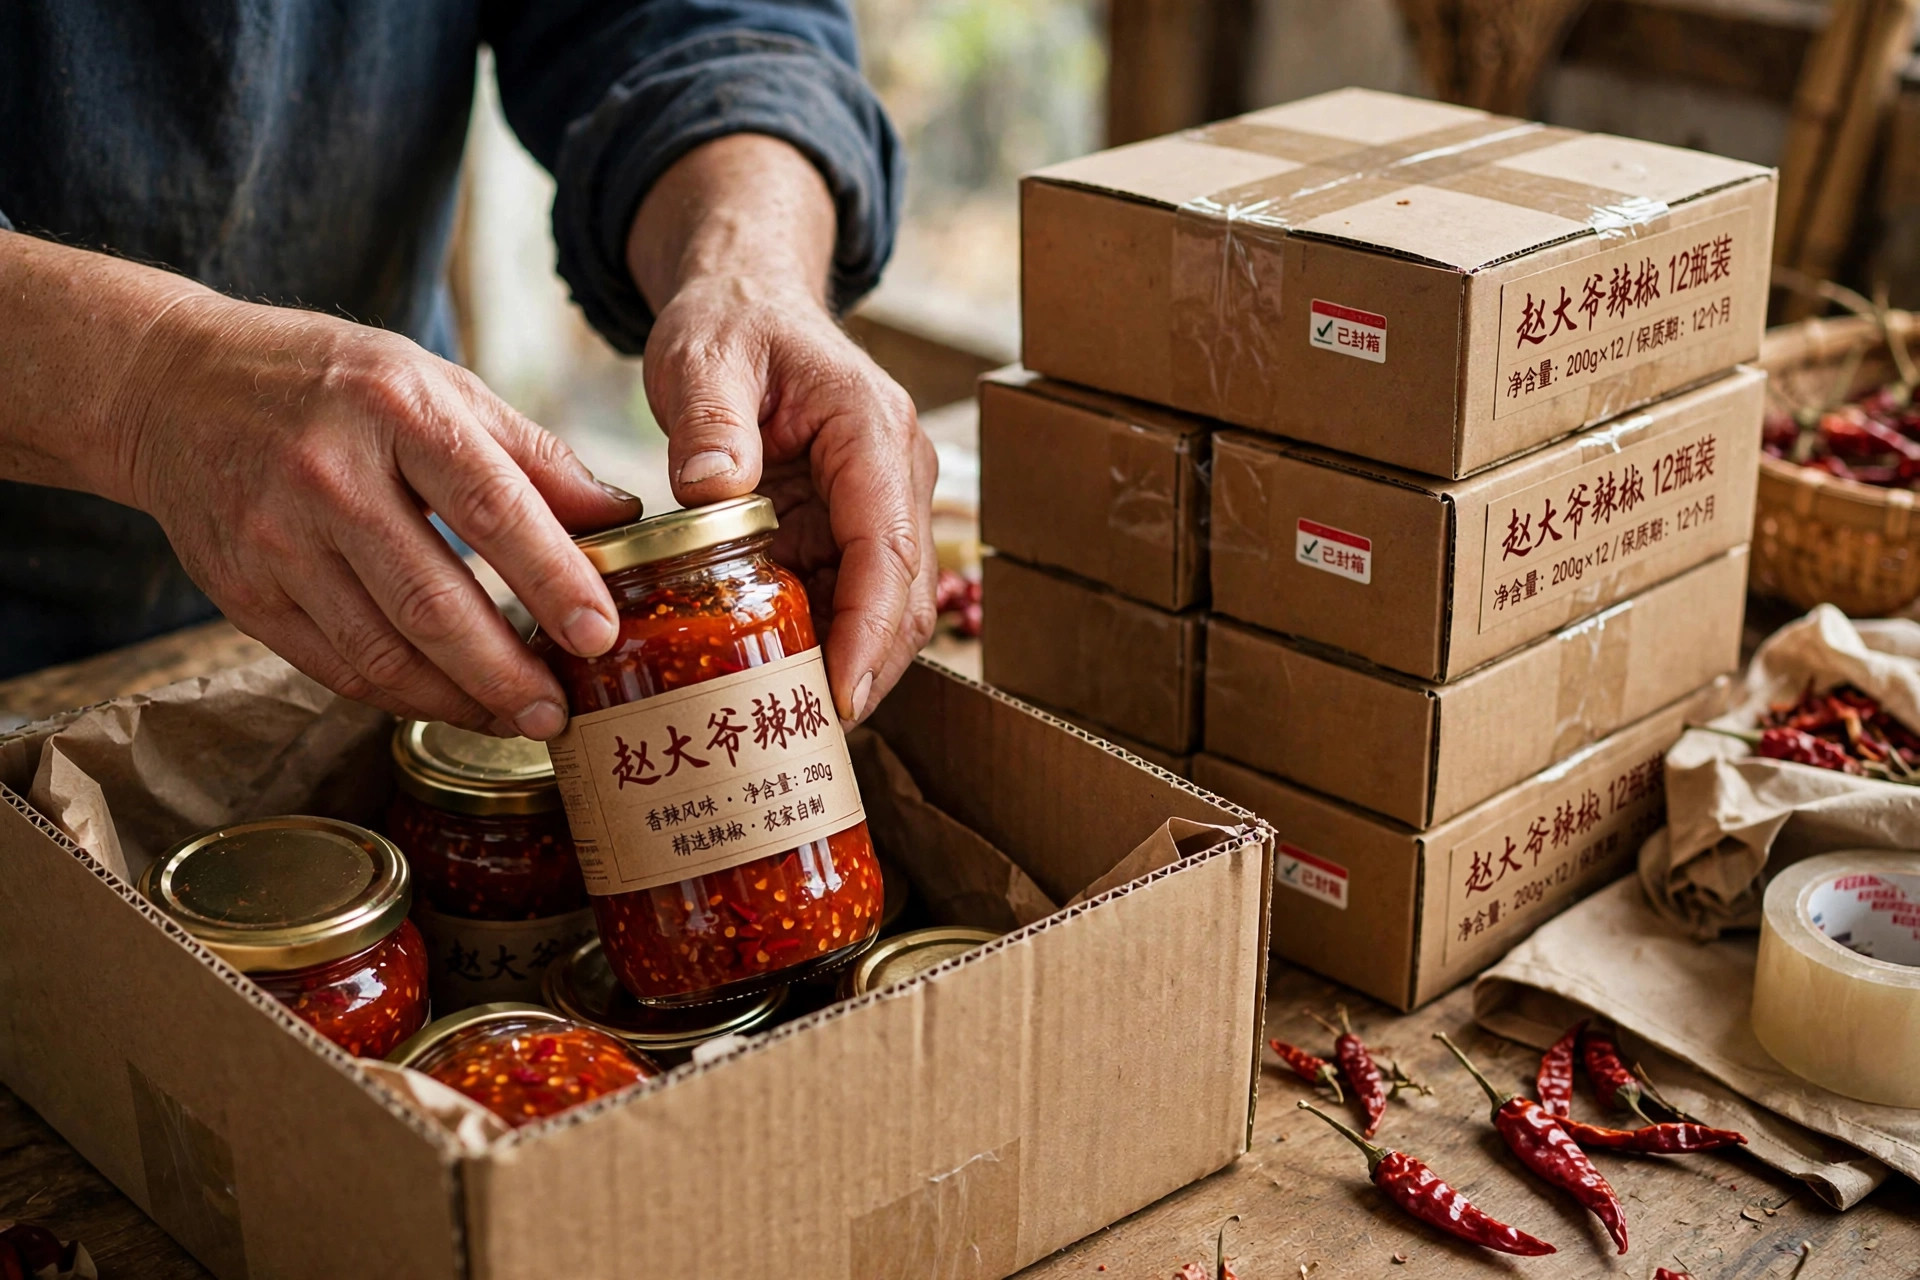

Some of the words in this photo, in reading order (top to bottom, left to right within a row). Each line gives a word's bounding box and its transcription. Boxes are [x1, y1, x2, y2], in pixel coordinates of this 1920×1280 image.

[1516, 257, 1661, 349] 赵大爷辣椒
[1668, 233, 1733, 295] 12瓶装
[1337, 326, 1381, 353] 已封箱
[1501, 463, 1645, 562] 赵大爷辣椒
[1652, 433, 1717, 497] 12瓶装
[1322, 545, 1366, 575] 已封箱
[611, 684, 830, 790] 赵大爷辣椒
[644, 795, 719, 832] 香辣风味
[671, 820, 747, 857] 精选辣椒
[763, 794, 826, 832] 农家自制
[1464, 788, 1603, 899] 赵大爷辣椒
